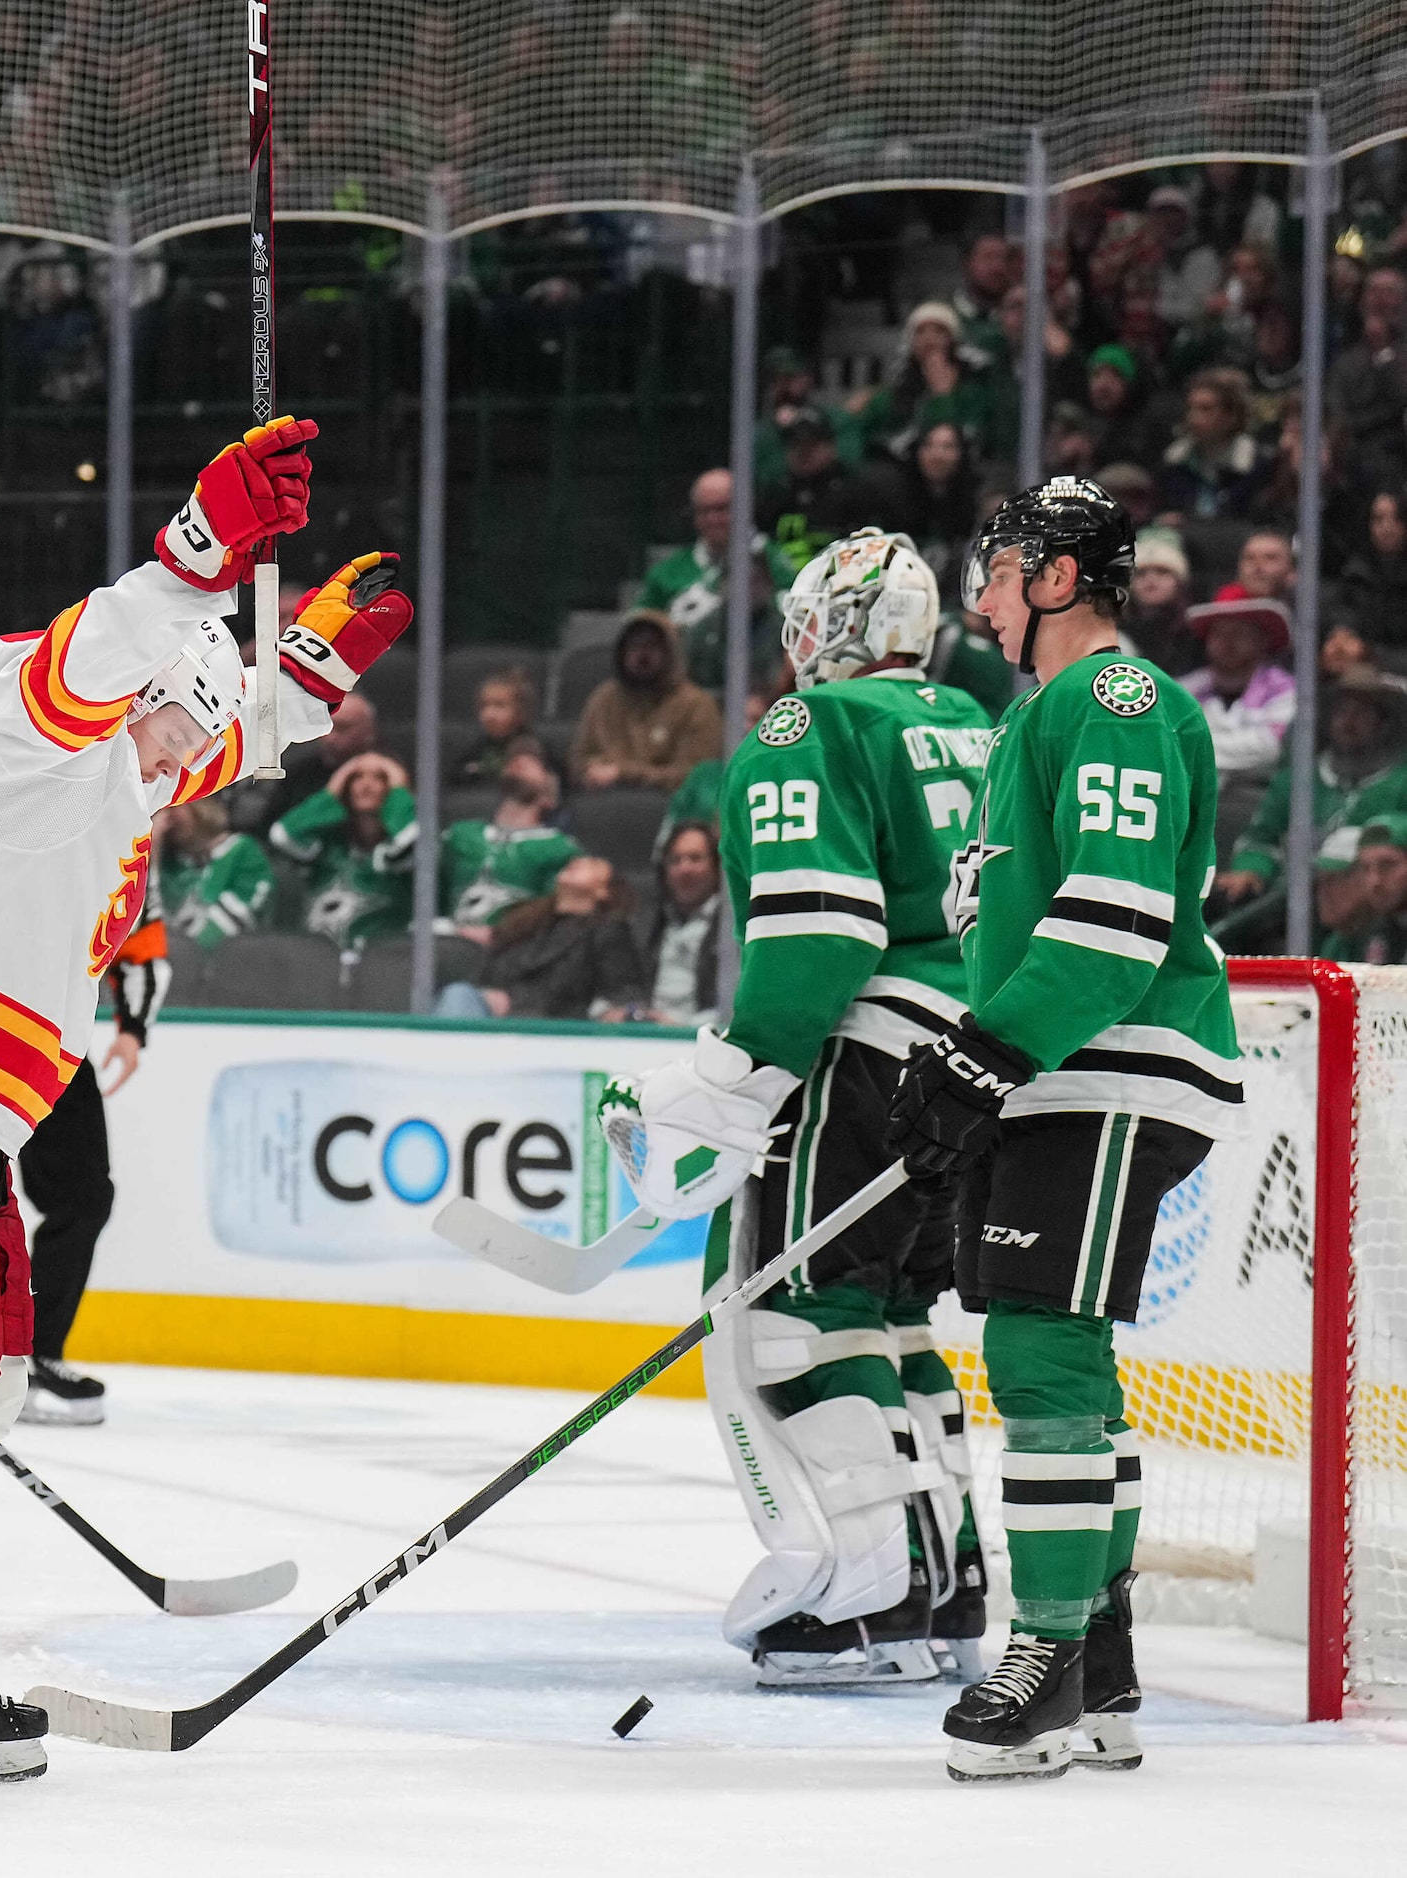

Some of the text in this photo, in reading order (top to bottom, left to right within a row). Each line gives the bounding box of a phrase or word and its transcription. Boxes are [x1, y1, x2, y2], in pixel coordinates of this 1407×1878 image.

[173, 560, 191, 573] ZARY
[747, 779, 820, 846] 29
[1076, 762, 1163, 842] 55
[932, 1033, 1017, 1098] CCM
[314, 1114, 574, 1211] core
[527, 1361, 661, 1476] JETSPEED
[322, 1522, 448, 1637] CCM
